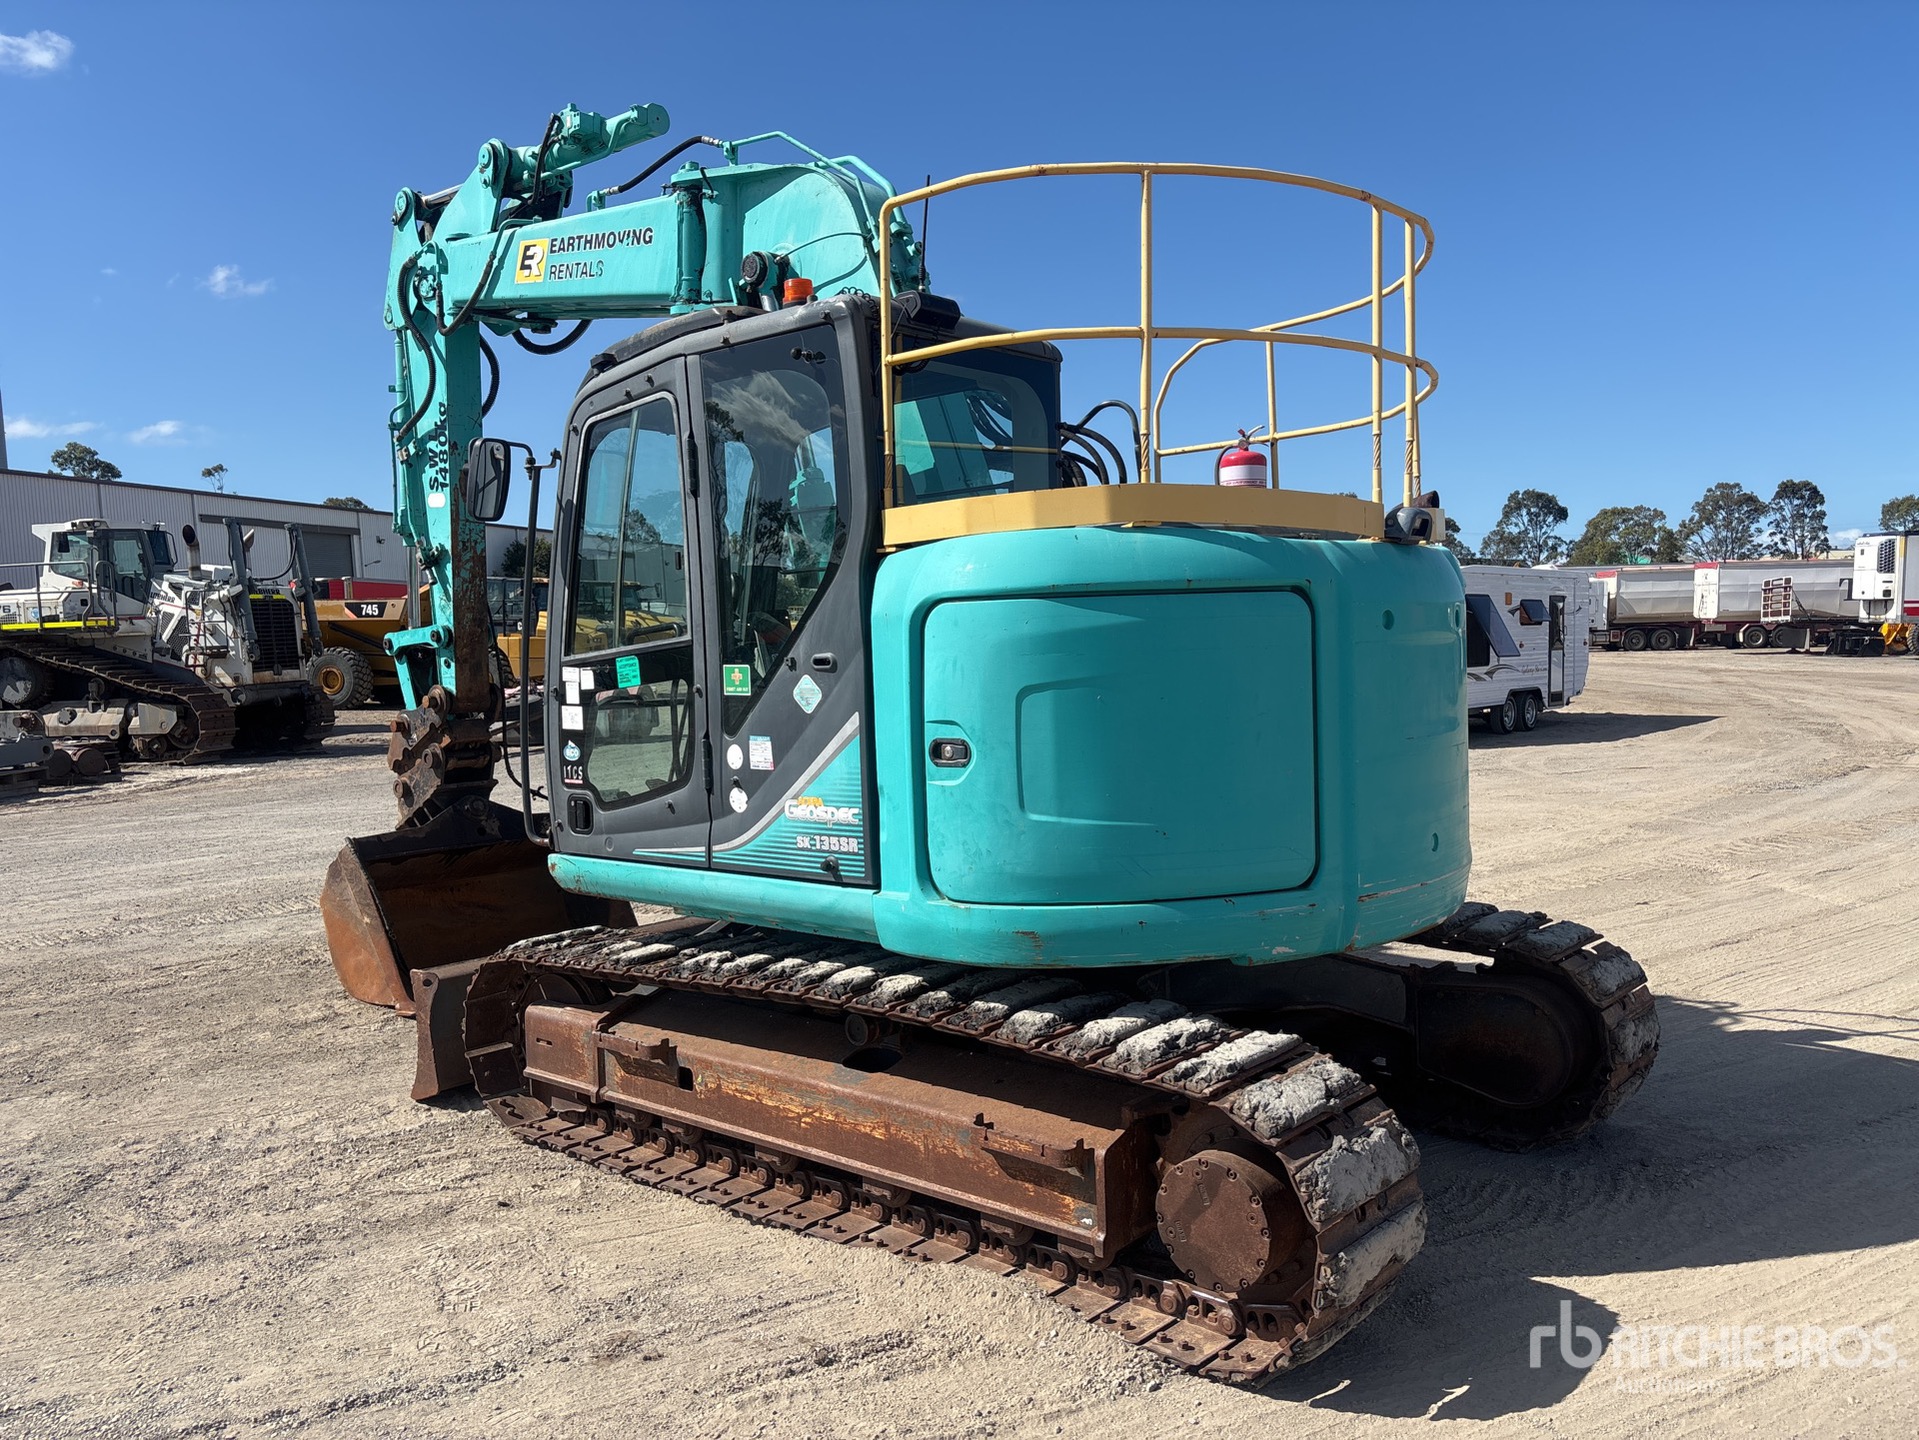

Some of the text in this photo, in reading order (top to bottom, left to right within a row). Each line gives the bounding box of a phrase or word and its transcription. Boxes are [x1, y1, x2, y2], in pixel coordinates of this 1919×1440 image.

[549, 227, 654, 254] EARTHMOVING
[548, 260, 605, 281] RENTALS
[360, 604, 379, 616] 745
